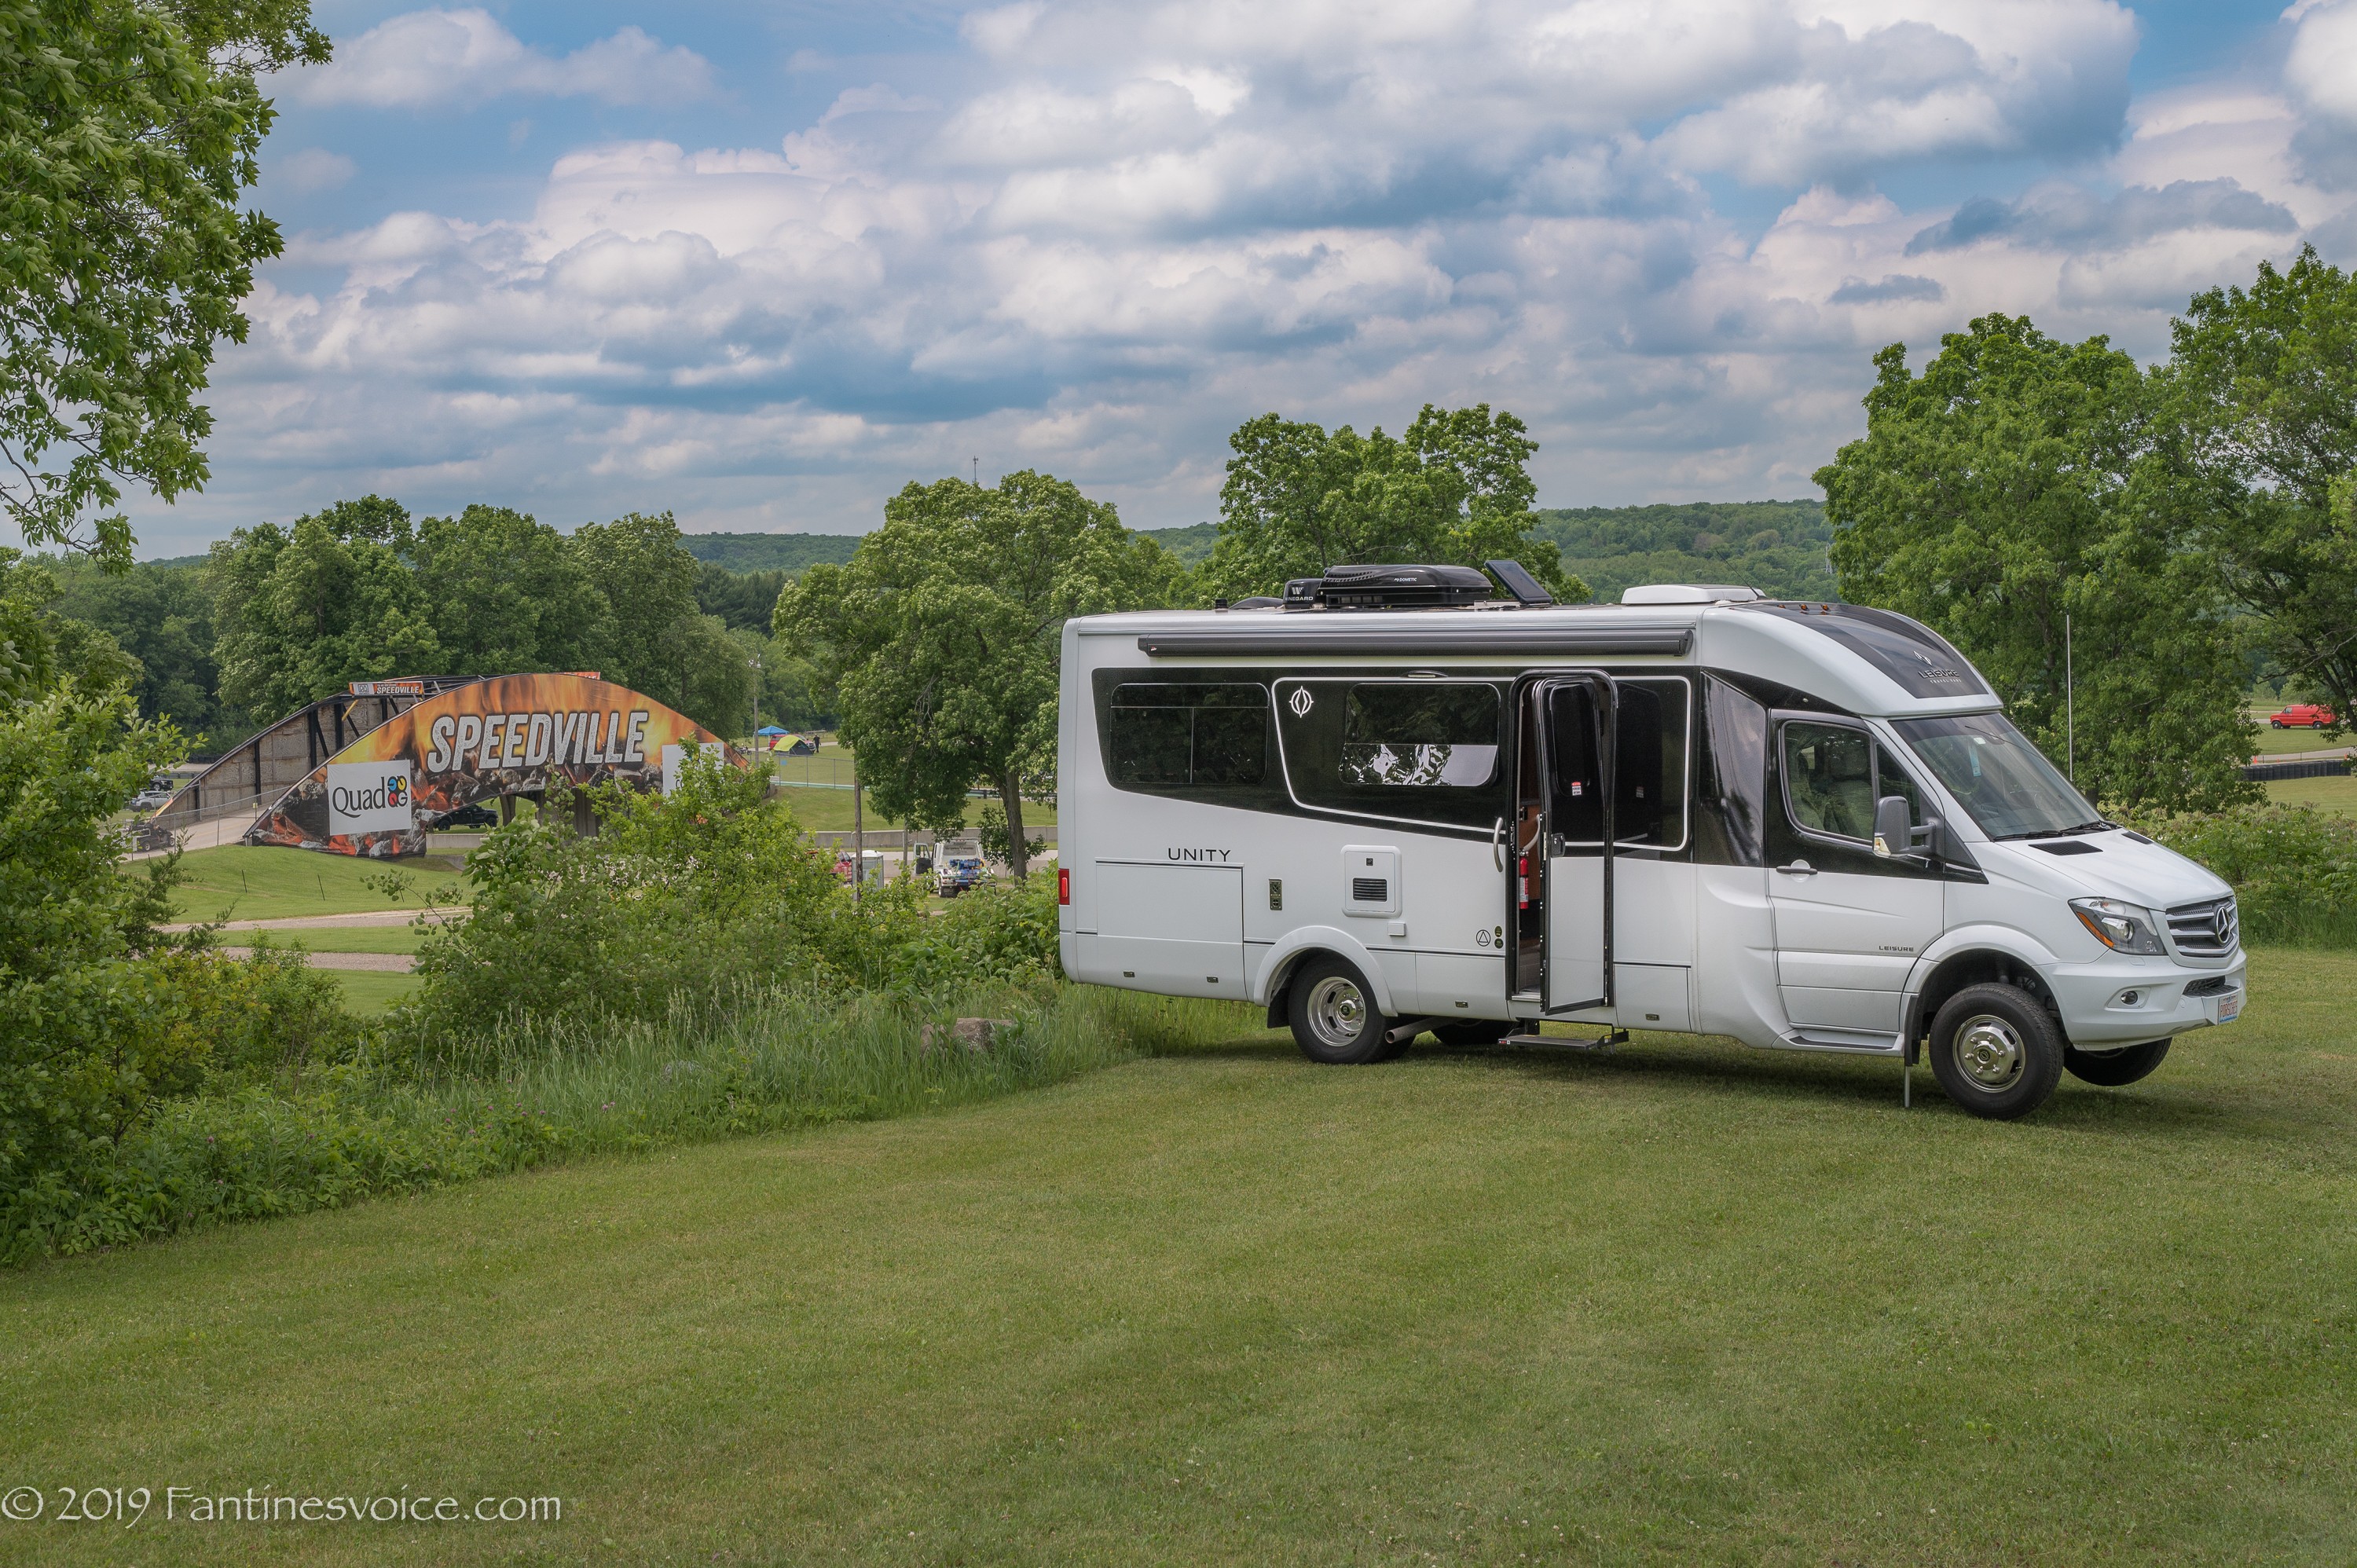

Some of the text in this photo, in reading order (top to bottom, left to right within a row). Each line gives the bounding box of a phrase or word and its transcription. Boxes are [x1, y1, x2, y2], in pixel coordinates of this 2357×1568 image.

[1918, 669, 1960, 679] LEISURE
[377, 686, 420, 694] SPEEDVILLE
[427, 712, 648, 773] SPEEDVILLE
[332, 776, 386, 818] Quad
[1168, 848, 1231, 862] UNITY
